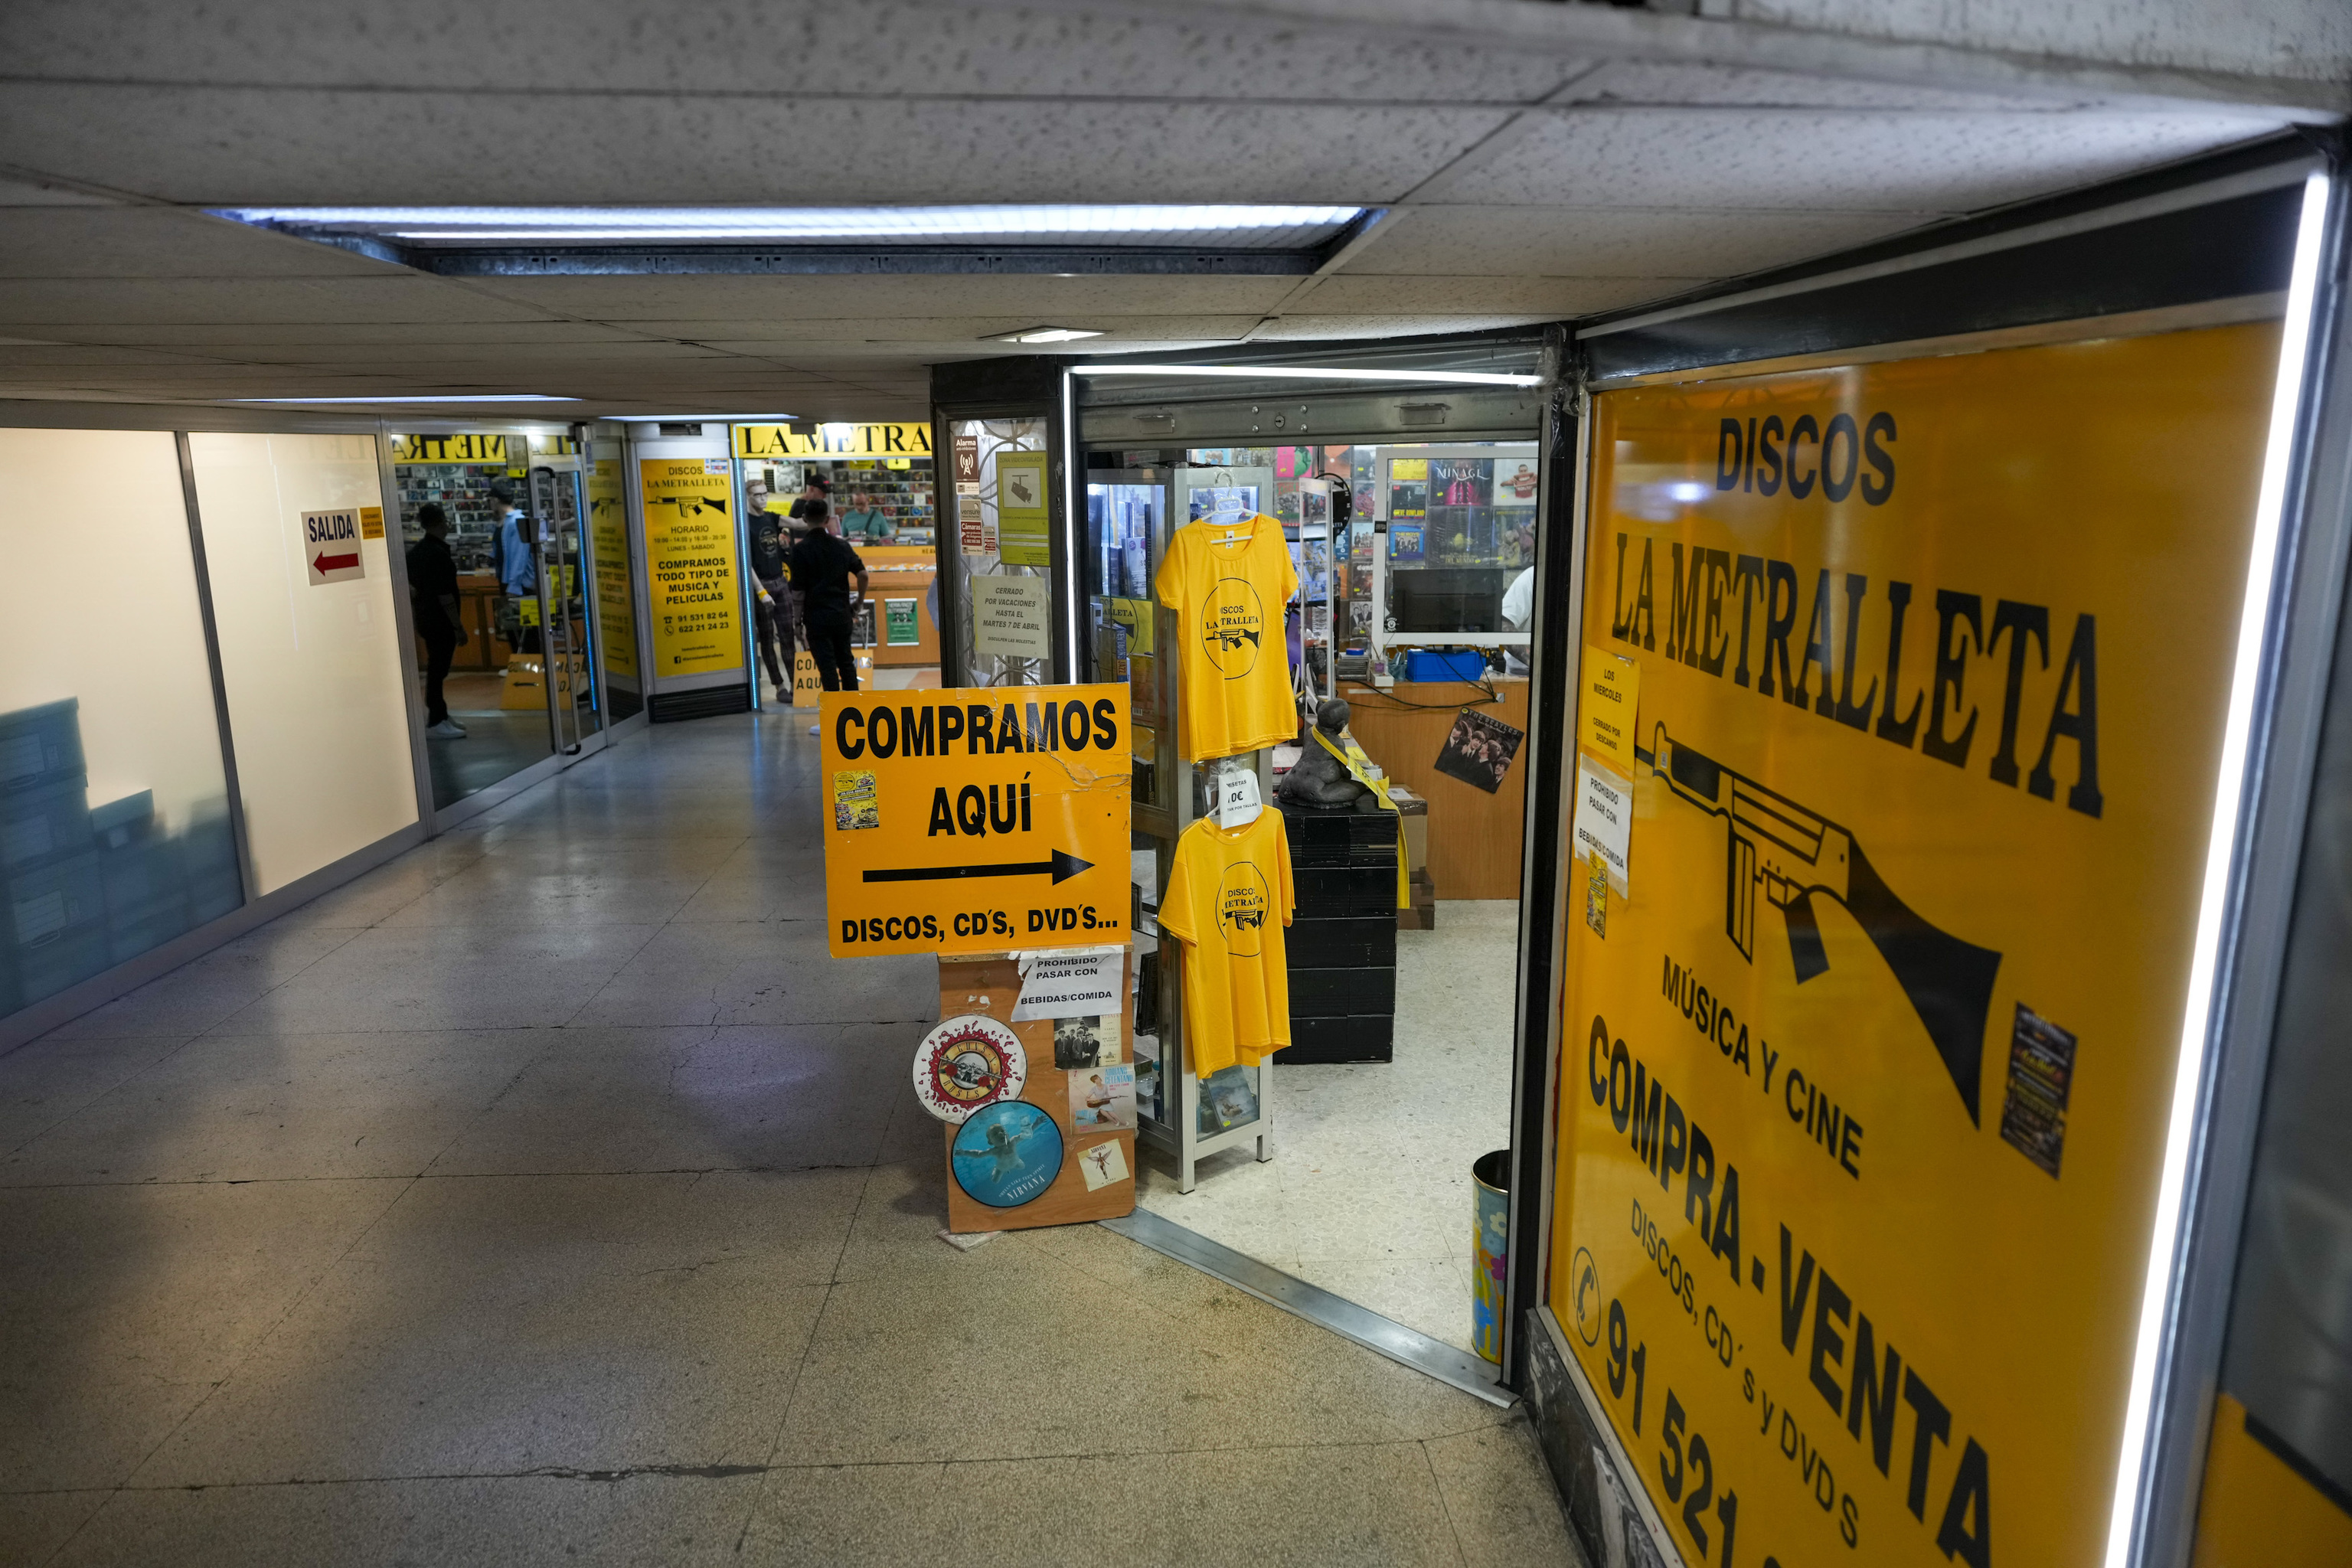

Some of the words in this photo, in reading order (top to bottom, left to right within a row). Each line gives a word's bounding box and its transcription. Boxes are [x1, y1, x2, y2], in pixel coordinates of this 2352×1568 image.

[743, 427, 792, 454] LA
[1716, 411, 1897, 506] DISCOS
[668, 466, 703, 475] DISCOS
[647, 479, 659, 488] LA
[662, 479, 724, 488] METRALLETA
[309, 514, 354, 542] SALIDA
[671, 524, 709, 534] HORARIO
[658, 557, 726, 570] COMPRAMOS
[656, 572, 685, 581] TODO
[689, 570, 713, 579] TIPO
[717, 569, 729, 577] DE
[668, 582, 710, 593] MUSICA
[666, 592, 724, 605] PELICULAS
[998, 599, 1036, 607] VACACIONES
[1220, 606, 1244, 614] ISCOS
[1206, 621, 1219, 629] LA
[1220, 616, 1259, 626] TRALLETA
[1604, 668, 1615, 681] LOS
[1612, 532, 1656, 652] LA
[1665, 541, 2104, 820] METRALLETA
[796, 677, 822, 690] AQU
[1593, 682, 1622, 704] MIERCOLES
[836, 698, 1117, 760] COMPRAMOS
[1468, 710, 1483, 720] THE
[1485, 718, 1518, 735] BEATLES
[1593, 717, 1612, 733] CERRADO
[1612, 727, 1621, 738] POR
[1596, 733, 1617, 750] DESCANSO
[1590, 777, 1619, 805] PROHIBIDO
[928, 771, 1031, 838] AQUÍ
[1589, 795, 1606, 816] PASAR
[1606, 808, 1617, 825] CON
[842, 914, 945, 943] DISCOS,
[1037, 957, 1098, 968] PROHIBIDO
[1036, 970, 1071, 979] PASAR
[1021, 991, 1112, 1004] BEBIDAS/COMIDA
[1662, 953, 1750, 1077] MÚSICA
[1761, 1039, 1779, 1096] Y
[1785, 1068, 1864, 1181] CINE
[1105, 1074, 1133, 1084] CELENTANO
[942, 1080, 979, 1099] ROSES
[1091, 1144, 1106, 1153] NIRVANA
[1007, 1174, 1045, 1201] NIRVANA
[1632, 1197, 1699, 1326] DISCOS,
[1761, 1390, 1775, 1436] y
[1606, 1298, 1646, 1439] 91
[1660, 1387, 1738, 1568] 521
